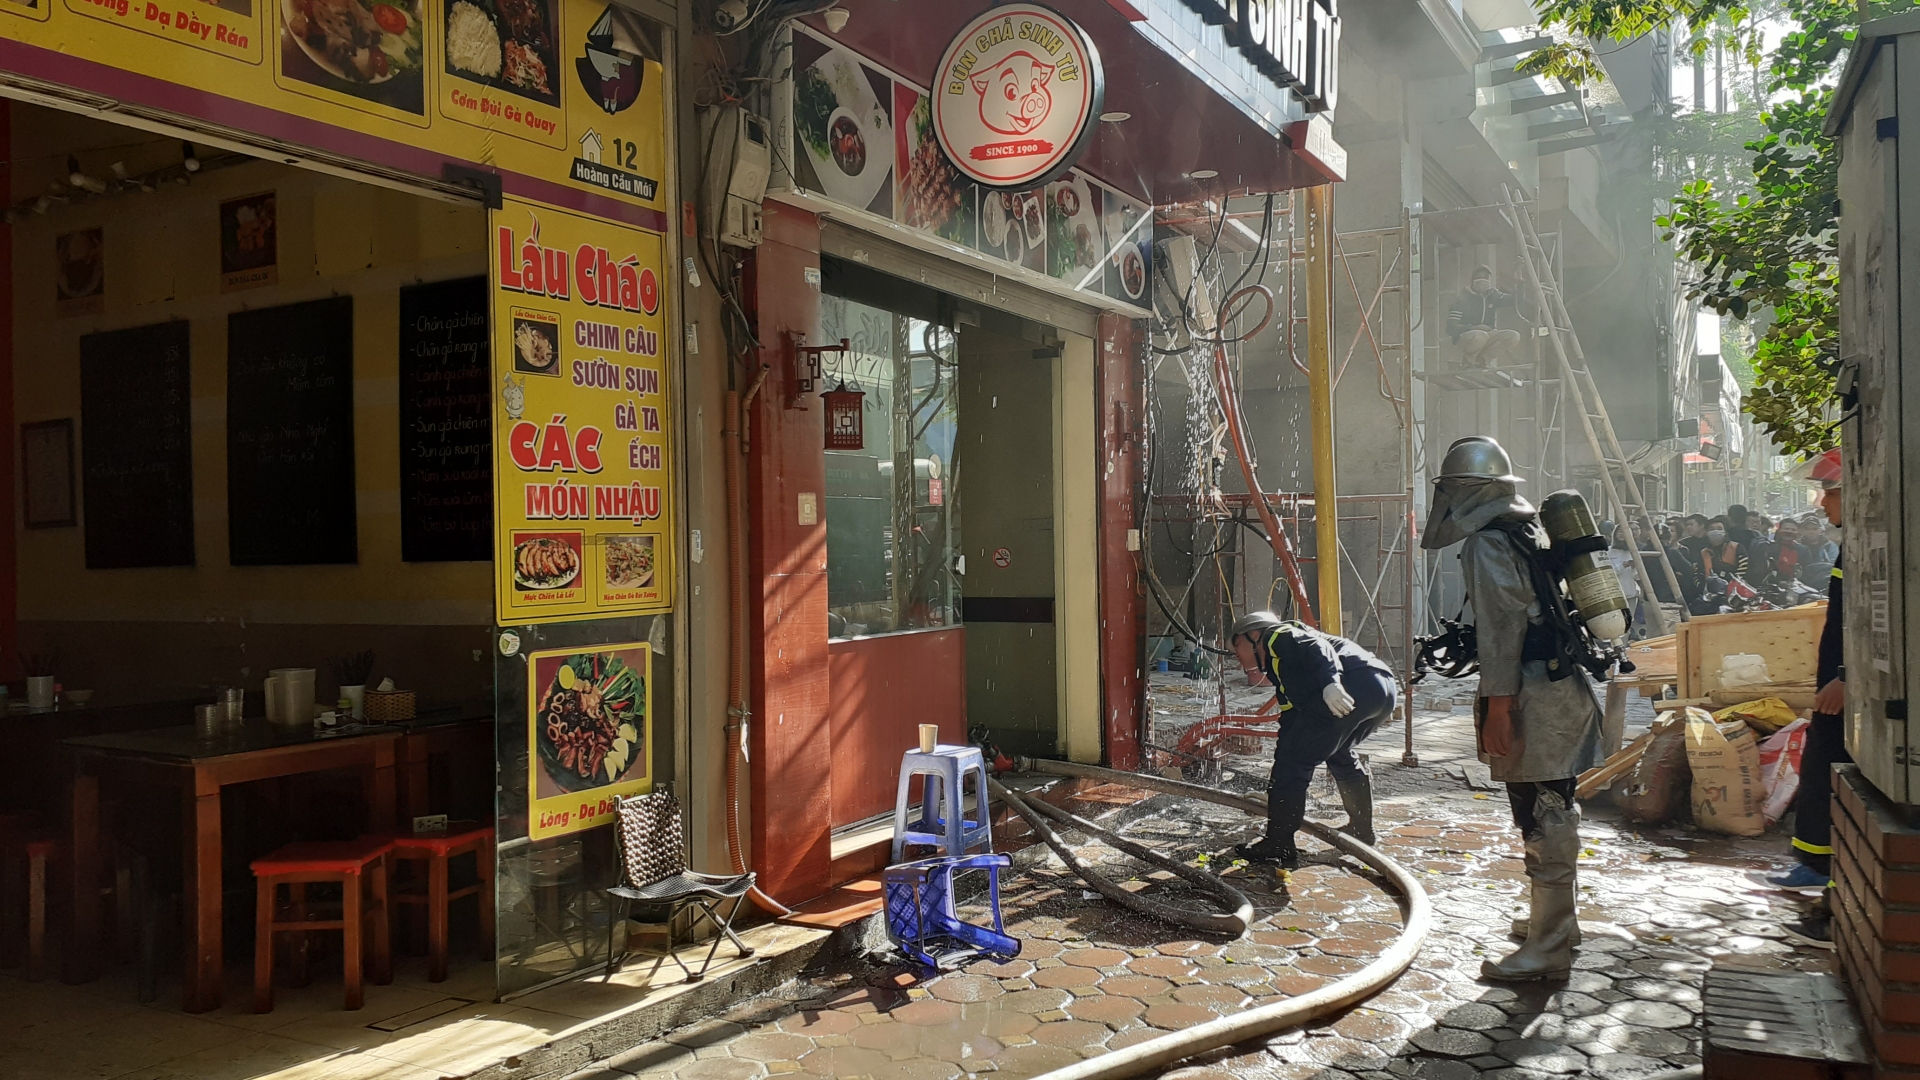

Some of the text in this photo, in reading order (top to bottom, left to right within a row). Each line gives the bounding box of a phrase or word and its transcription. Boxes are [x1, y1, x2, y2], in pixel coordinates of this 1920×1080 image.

[145, 1, 170, 30] Dạ
[175, 11, 212, 40] Dầy
[215, 24, 249, 49] Rán
[948, 50, 978, 95] BÚN
[975, 17, 1015, 53] CHẢ
[1019, 21, 1064, 56] SINH
[450, 88, 478, 111] Cơm
[504, 105, 522, 123] Gà
[525, 111, 557, 136] Quay
[612, 138, 638, 171] 12
[986, 144, 1039, 157] SINCE 1900
[576, 162, 610, 188] Hoàng
[633, 181, 653, 198] Mới
[574, 244, 659, 315] Cháo
[574, 320, 658, 357] CHIM CÂU
[572, 356, 659, 398] SƯỜN SỤN
[614, 401, 661, 433] GÀ TA
[509, 413, 604, 475] CÁC
[629, 436, 661, 470] ẾCH
[525, 477, 662, 527] MÓN NHẬU
[539, 808, 570, 830] Lòng
[579, 802, 595, 822] Dạ
[598, 794, 615, 817] Dầ
